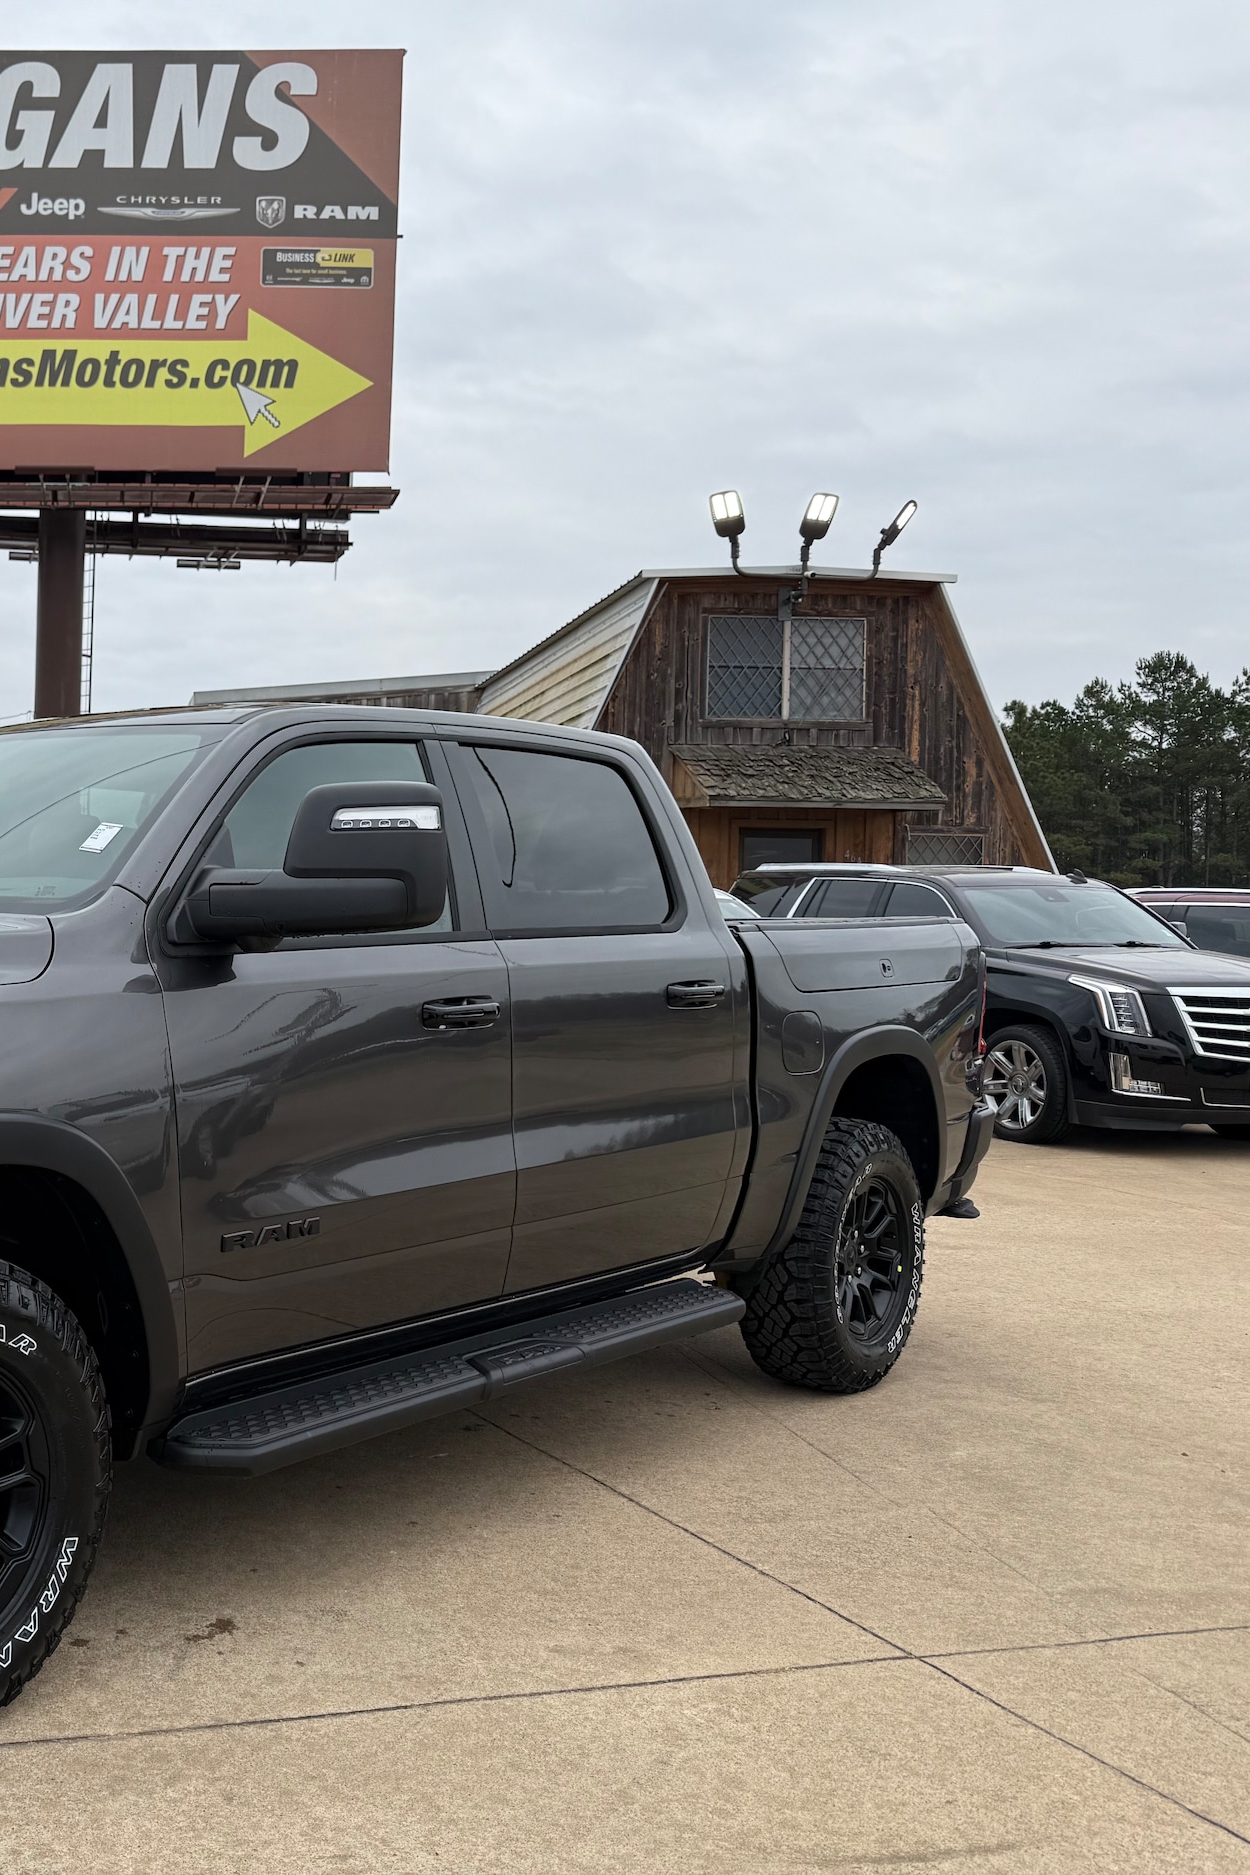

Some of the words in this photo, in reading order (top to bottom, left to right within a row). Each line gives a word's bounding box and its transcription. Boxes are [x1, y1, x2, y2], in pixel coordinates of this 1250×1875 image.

[19, 192, 85, 220] Jeep
[115, 195, 222, 206] CHRYSLER
[293, 204, 380, 221] RAM
[104, 246, 150, 283] IN
[161, 246, 237, 283] THE
[333, 253, 355, 263] LINK
[93, 293, 241, 331] VALLEY
[220, 1216, 321, 1253] RAM
